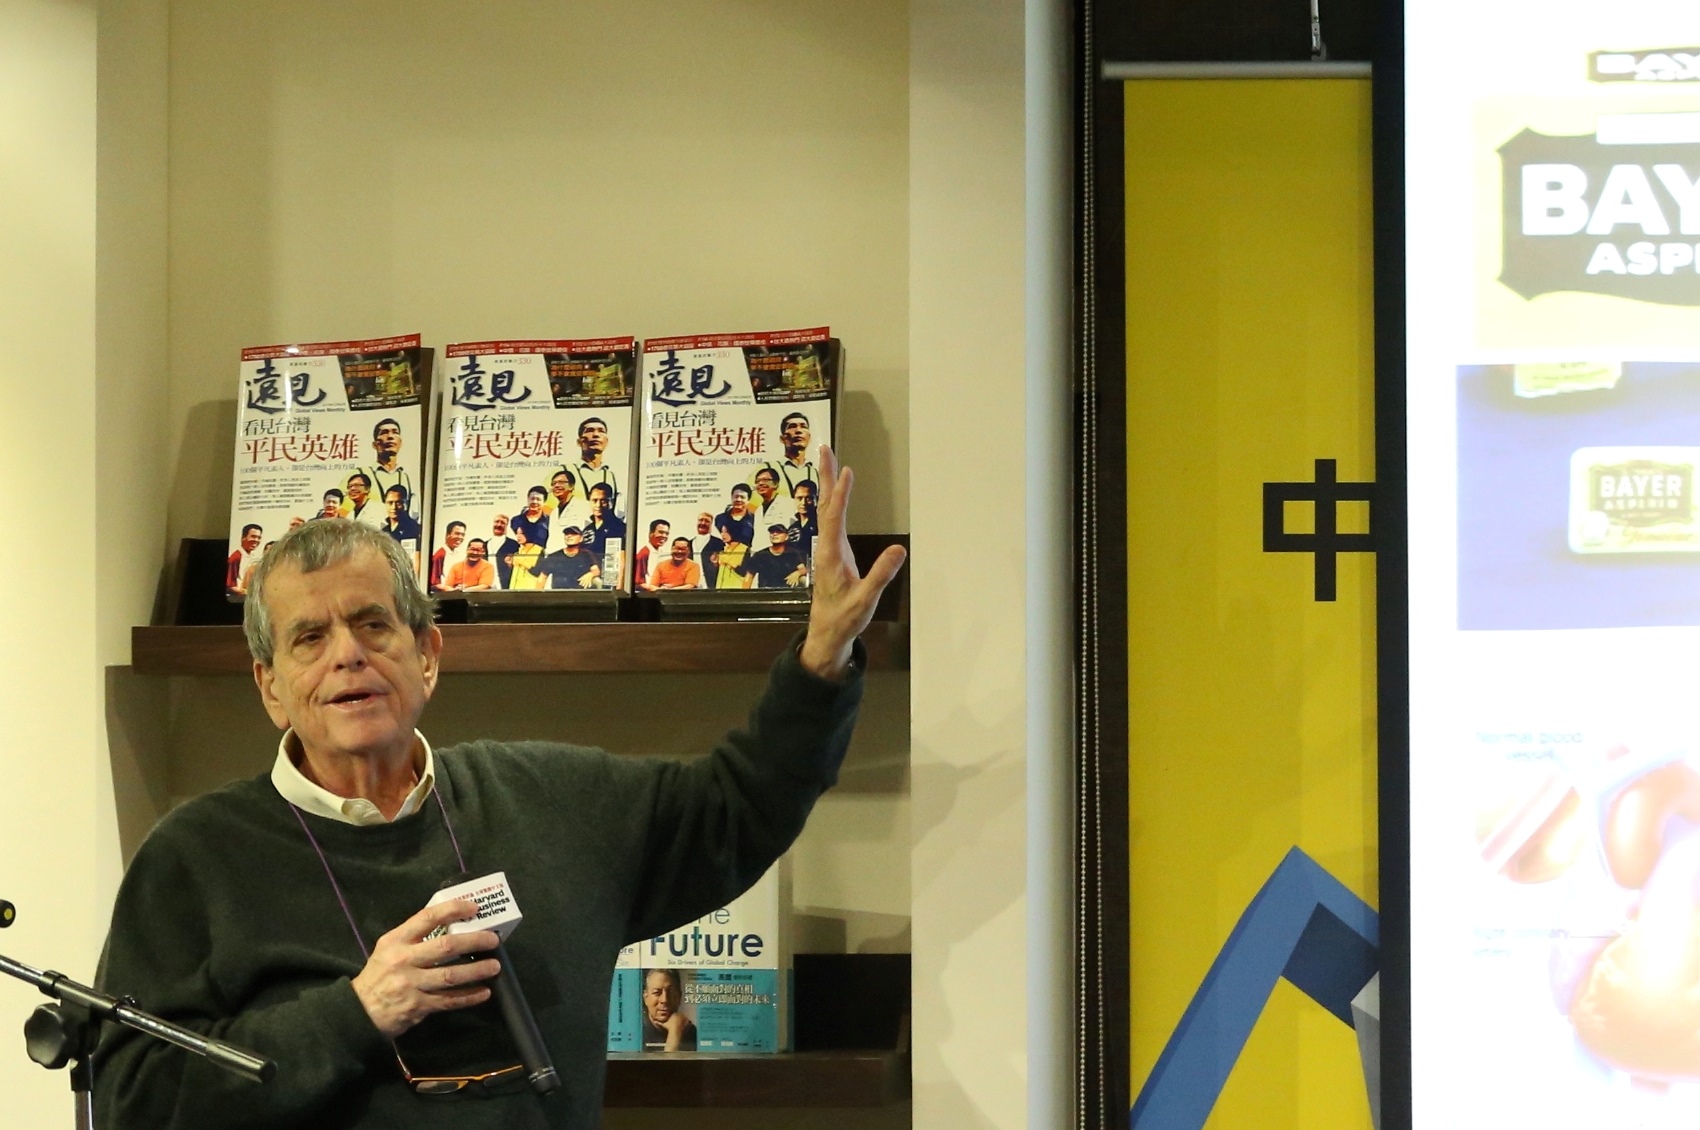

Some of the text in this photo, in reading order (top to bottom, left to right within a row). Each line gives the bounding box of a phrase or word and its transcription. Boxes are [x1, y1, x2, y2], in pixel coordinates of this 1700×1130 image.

[245, 359, 327, 415] 遠見
[450, 355, 532, 411] 遠見
[650, 350, 732, 408] 遠見
[243, 417, 311, 436] 看見台灣
[646, 426, 766, 458] 平民英雄
[241, 433, 359, 464] 平民英雄
[1600, 474, 1682, 497] BAYER
[476, 906, 507, 920] Review
[477, 897, 510, 912] usiness
[650, 926, 764, 957] Future
